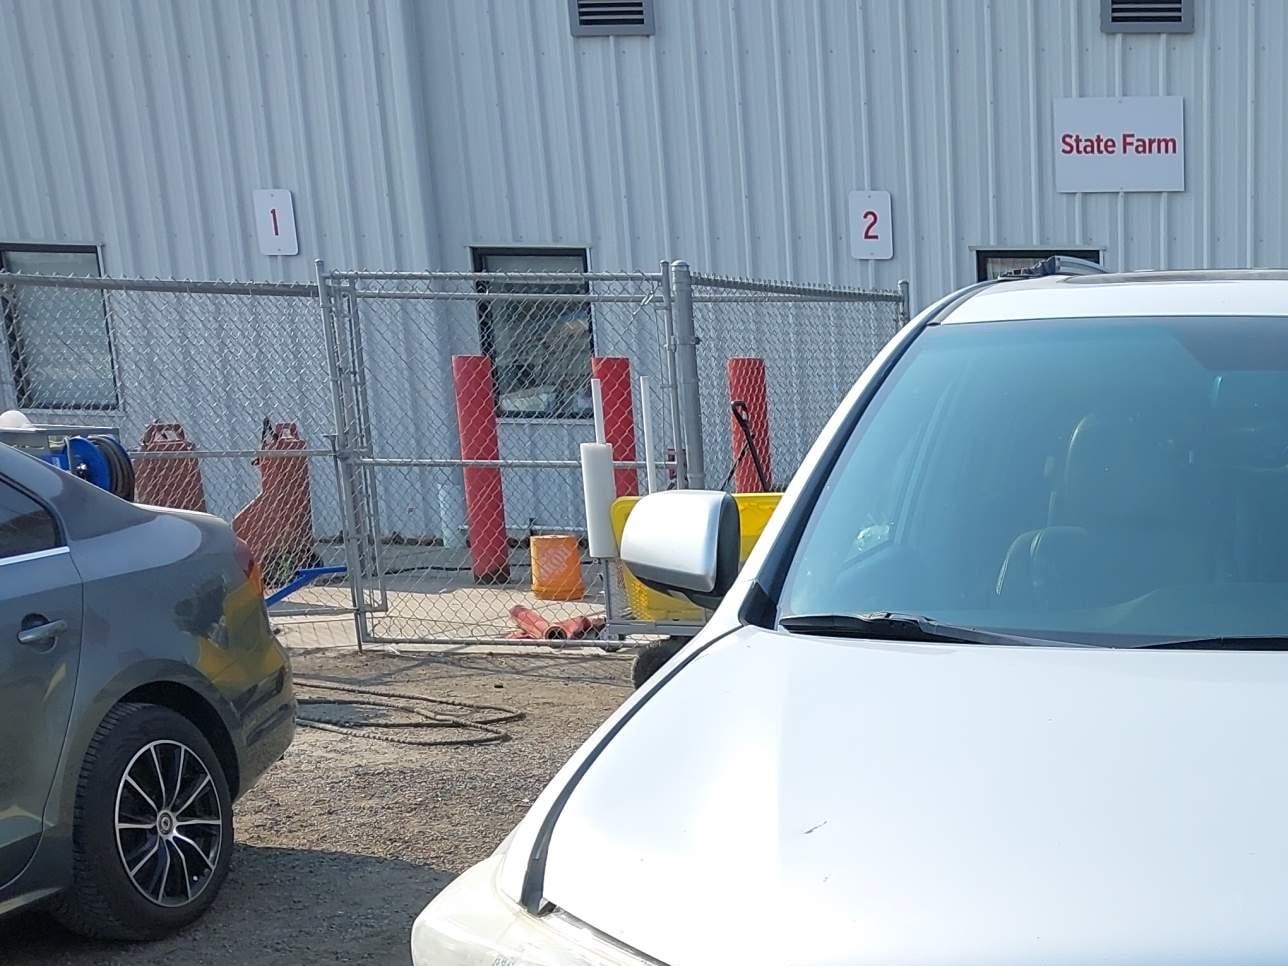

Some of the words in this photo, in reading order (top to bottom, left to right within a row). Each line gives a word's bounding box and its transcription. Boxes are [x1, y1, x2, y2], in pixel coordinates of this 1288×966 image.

[1061, 134, 1116, 154] State
[1122, 134, 1177, 154] Farm
[270, 208, 279, 236] 1
[862, 210, 879, 240] 2
